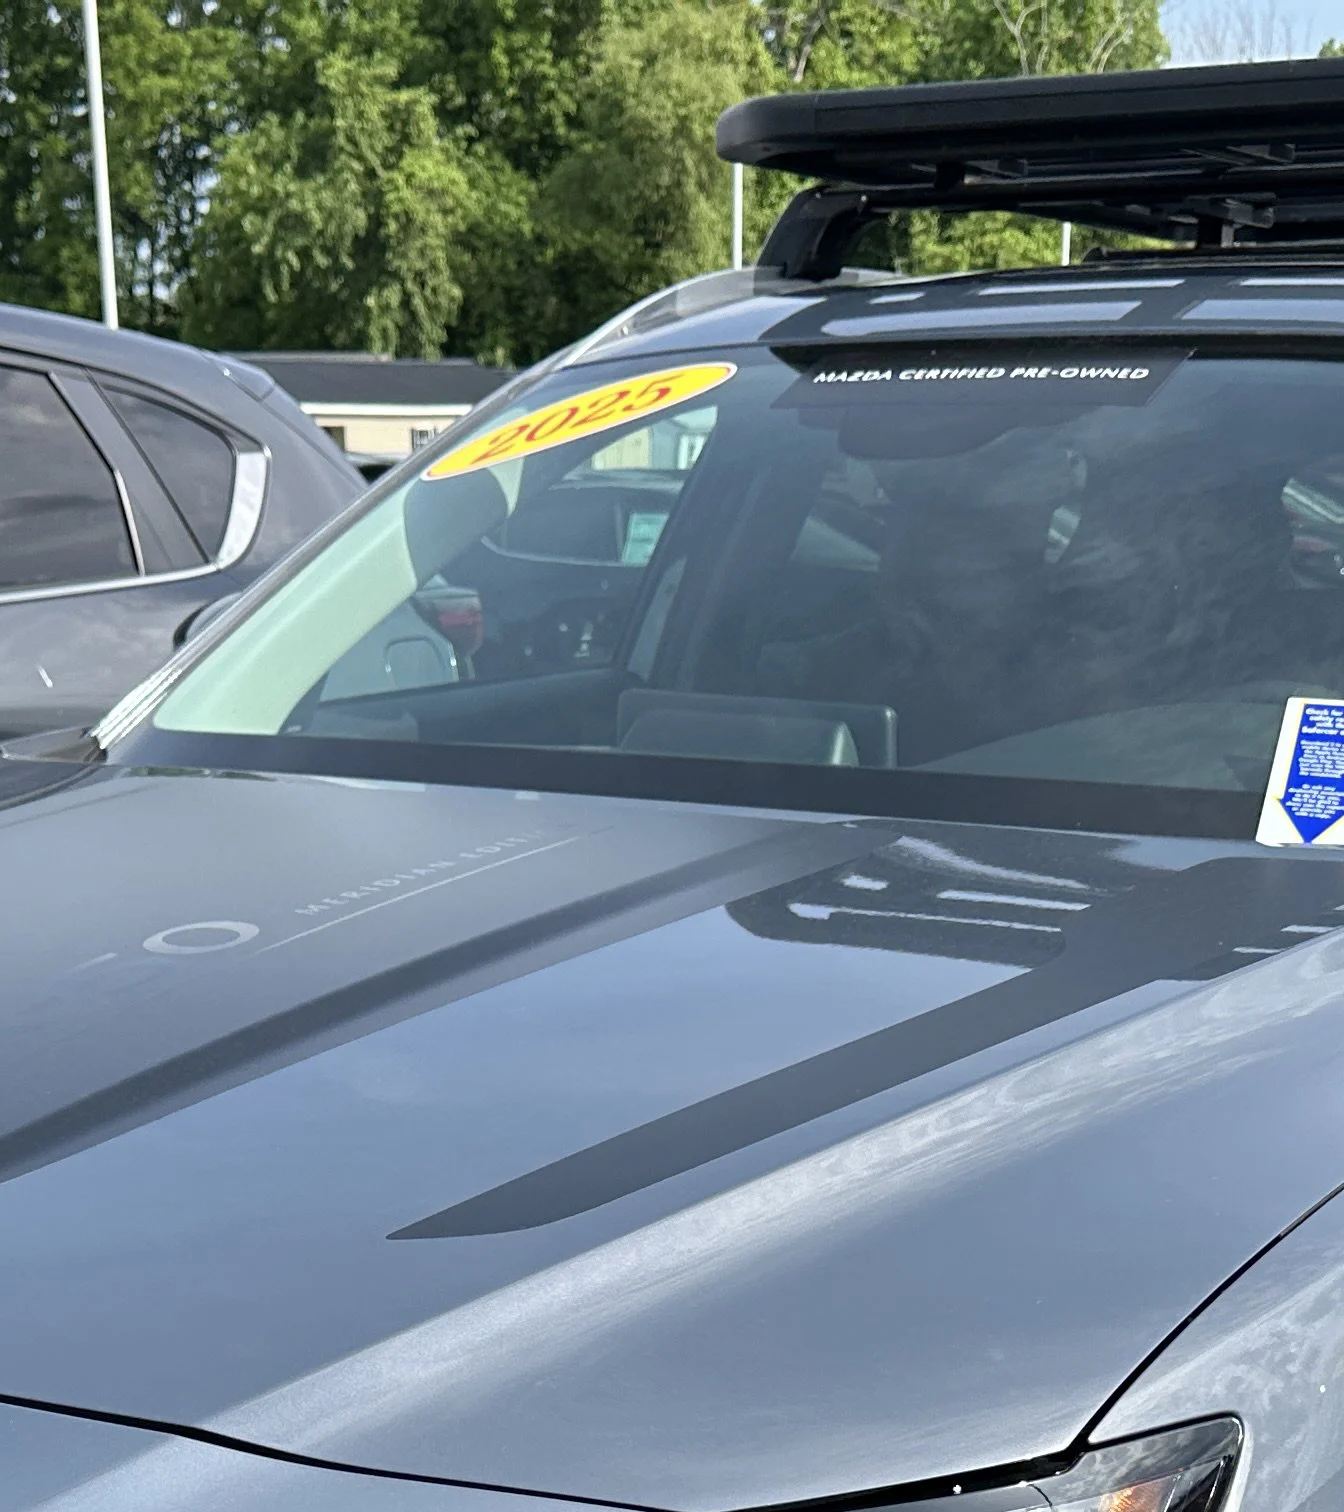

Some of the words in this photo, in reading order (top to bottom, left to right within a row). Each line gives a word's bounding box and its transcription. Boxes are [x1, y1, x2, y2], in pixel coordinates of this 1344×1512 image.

[813, 370, 891, 384] MAZDA
[898, 367, 1006, 381] CERTIFIED
[1009, 366, 1150, 381] PRE-OWNED
[470, 374, 685, 466] 2025
